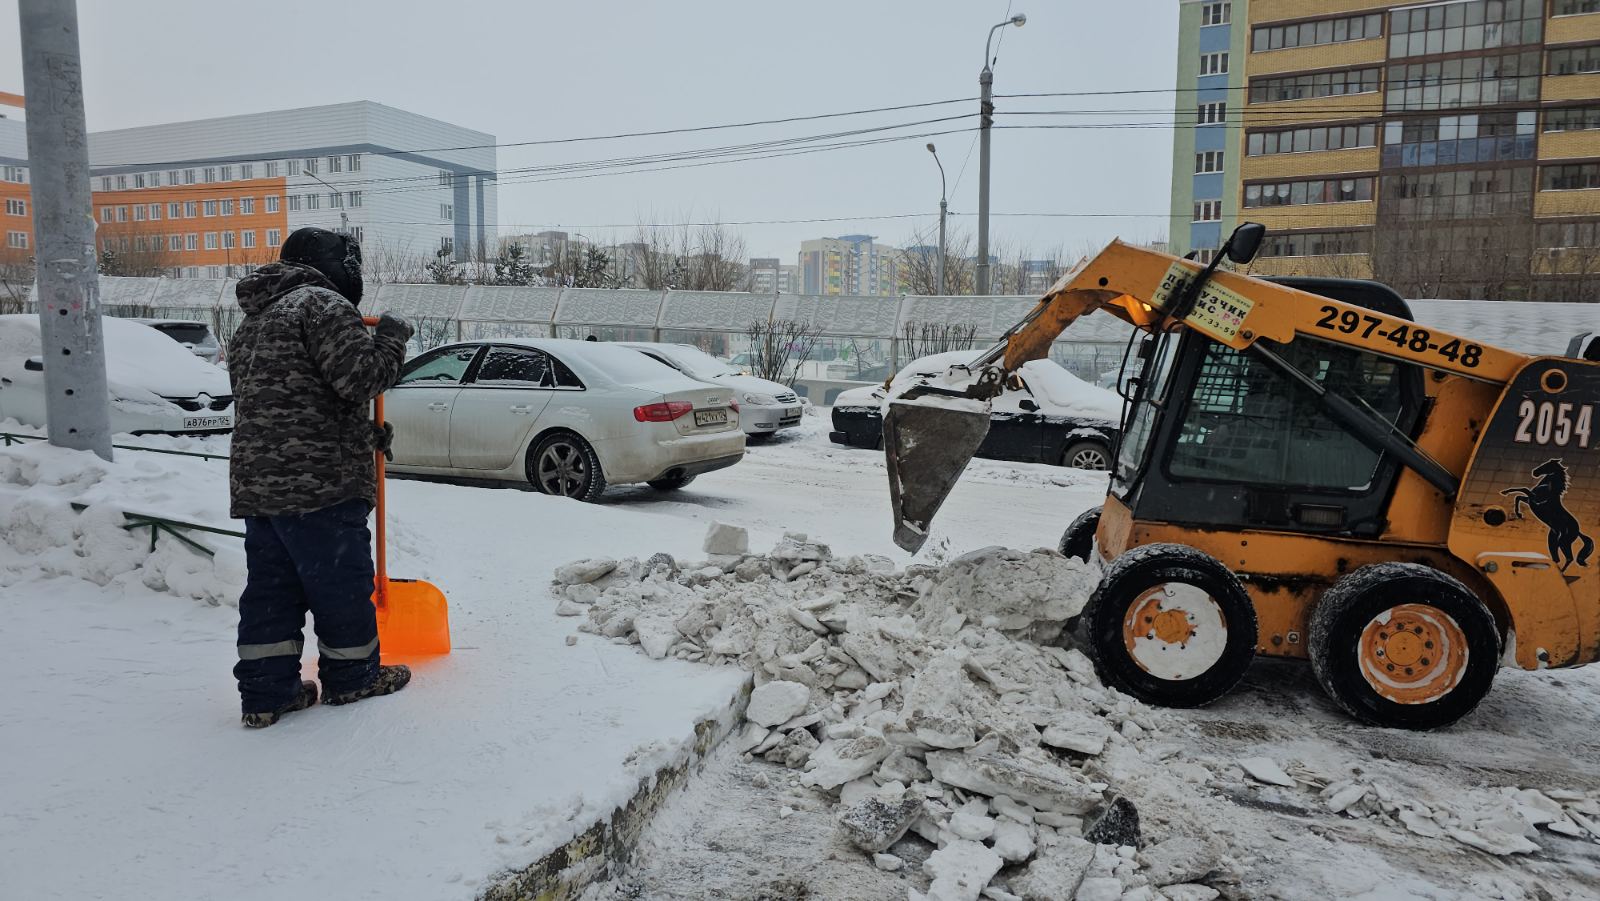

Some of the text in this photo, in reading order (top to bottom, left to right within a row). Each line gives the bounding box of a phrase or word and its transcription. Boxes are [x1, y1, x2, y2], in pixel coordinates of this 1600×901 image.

[1167, 273, 1247, 319] ПОГУЗЧИК
[1315, 305, 1483, 368] 297-48-48
[1514, 399, 1594, 449] 2054
